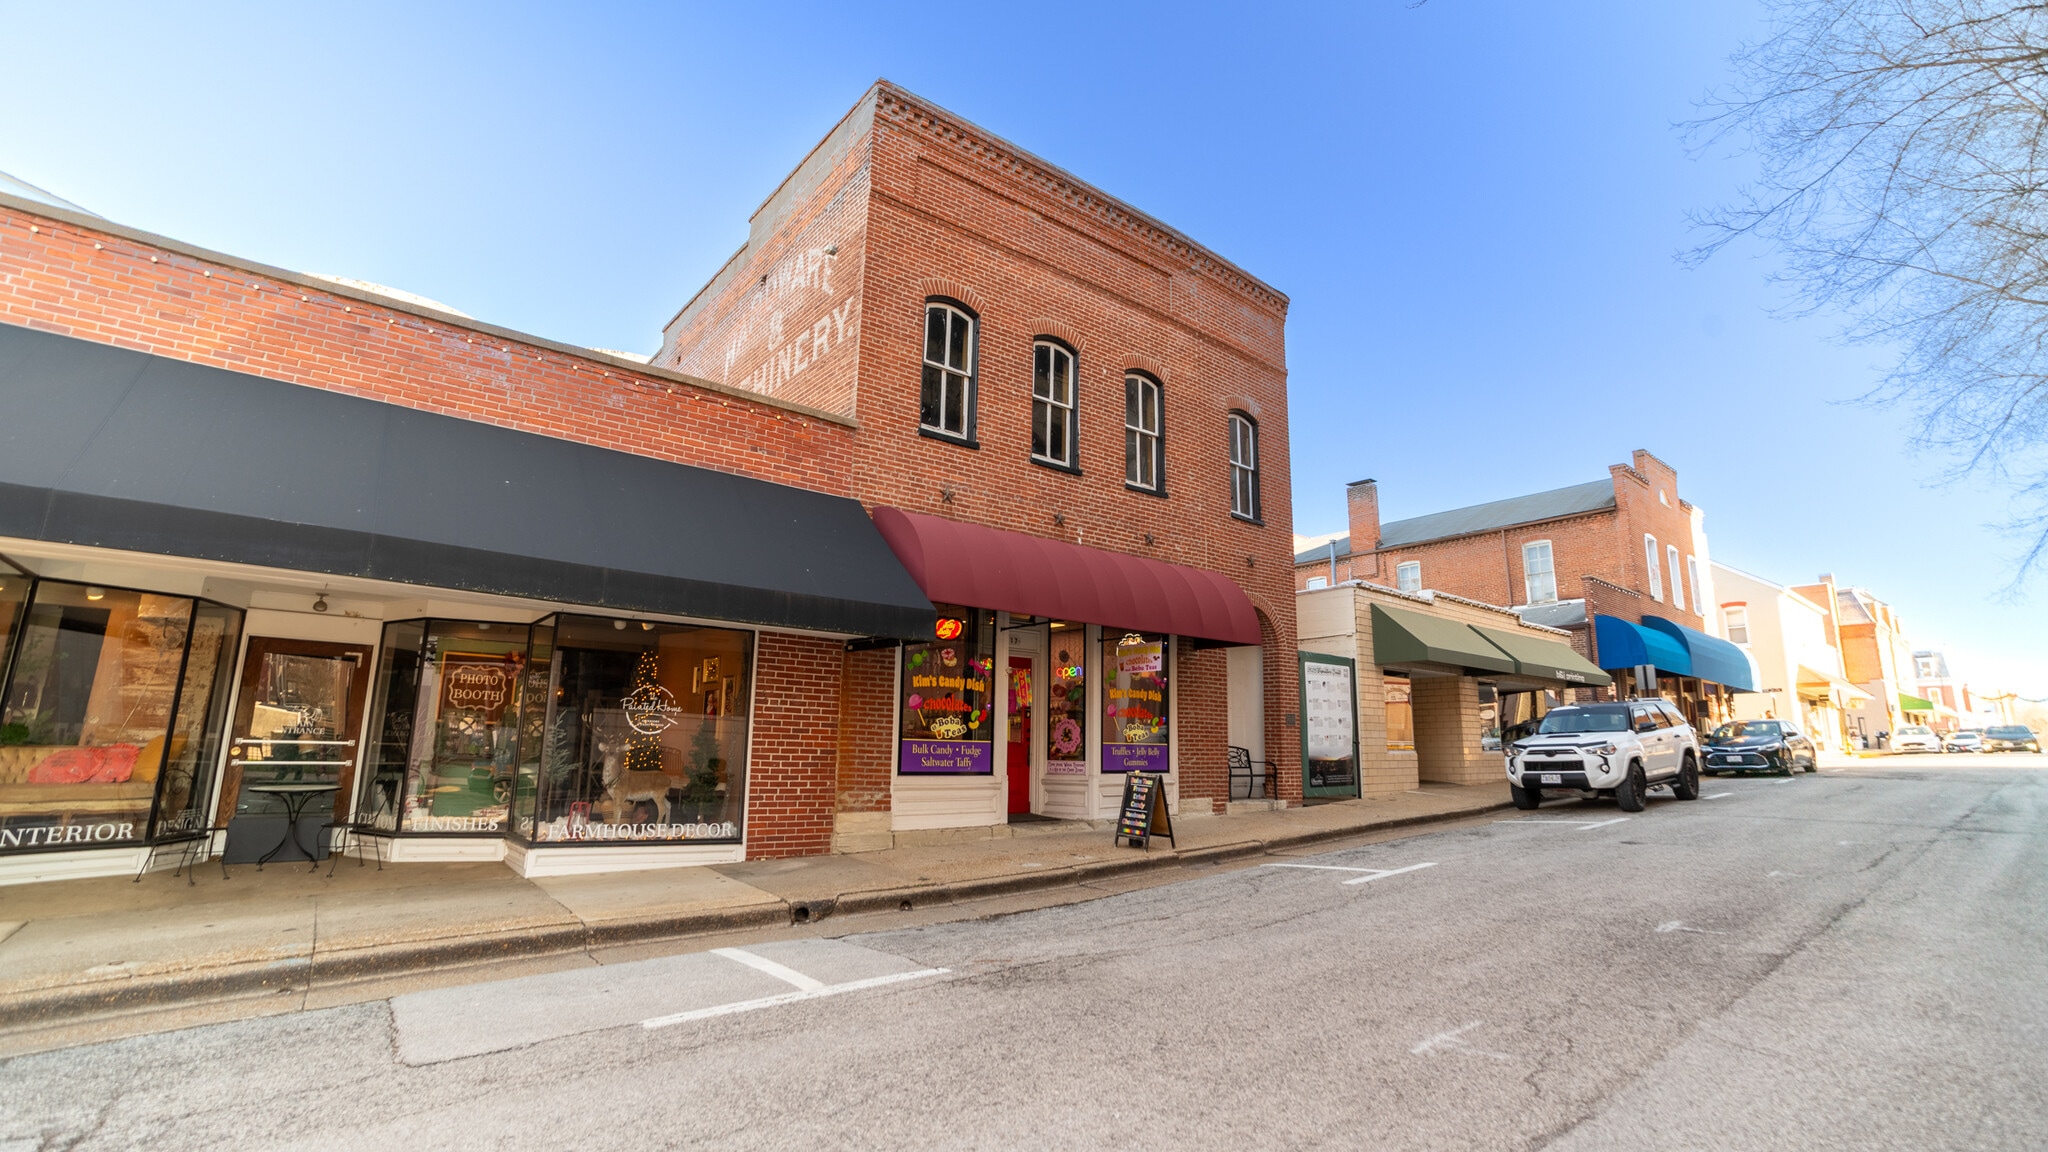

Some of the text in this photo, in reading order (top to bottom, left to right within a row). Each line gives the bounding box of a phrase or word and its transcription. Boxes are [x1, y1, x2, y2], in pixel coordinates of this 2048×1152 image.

[1056, 666, 1083, 679] open
[459, 673, 499, 686] PHOTO
[912, 674, 985, 692] Kim's Candy Dish
[1019, 670, 1028, 705] OPEN
[453, 688, 500, 701] BOOTH
[1109, 687, 1162, 702] Kim's Candy Dish
[656, 699, 683, 712] Home
[938, 717, 960, 727] Boba
[944, 726, 967, 737] Teas
[1133, 732, 1149, 740] Teas
[912, 744, 982, 758] Bulk Candy Fudge
[1111, 746, 1160, 758] Truffles Jelly Belly
[921, 756, 972, 769] Saltwater Taffy
[1123, 757, 1149, 767] Gummies
[1130, 801, 1146, 810] Candy
[411, 815, 500, 832] FINISHES
[1121, 817, 1147, 828] Chocolates
[549, 823, 671, 839] FARMHOUSE
[671, 821, 733, 838] DECOR
